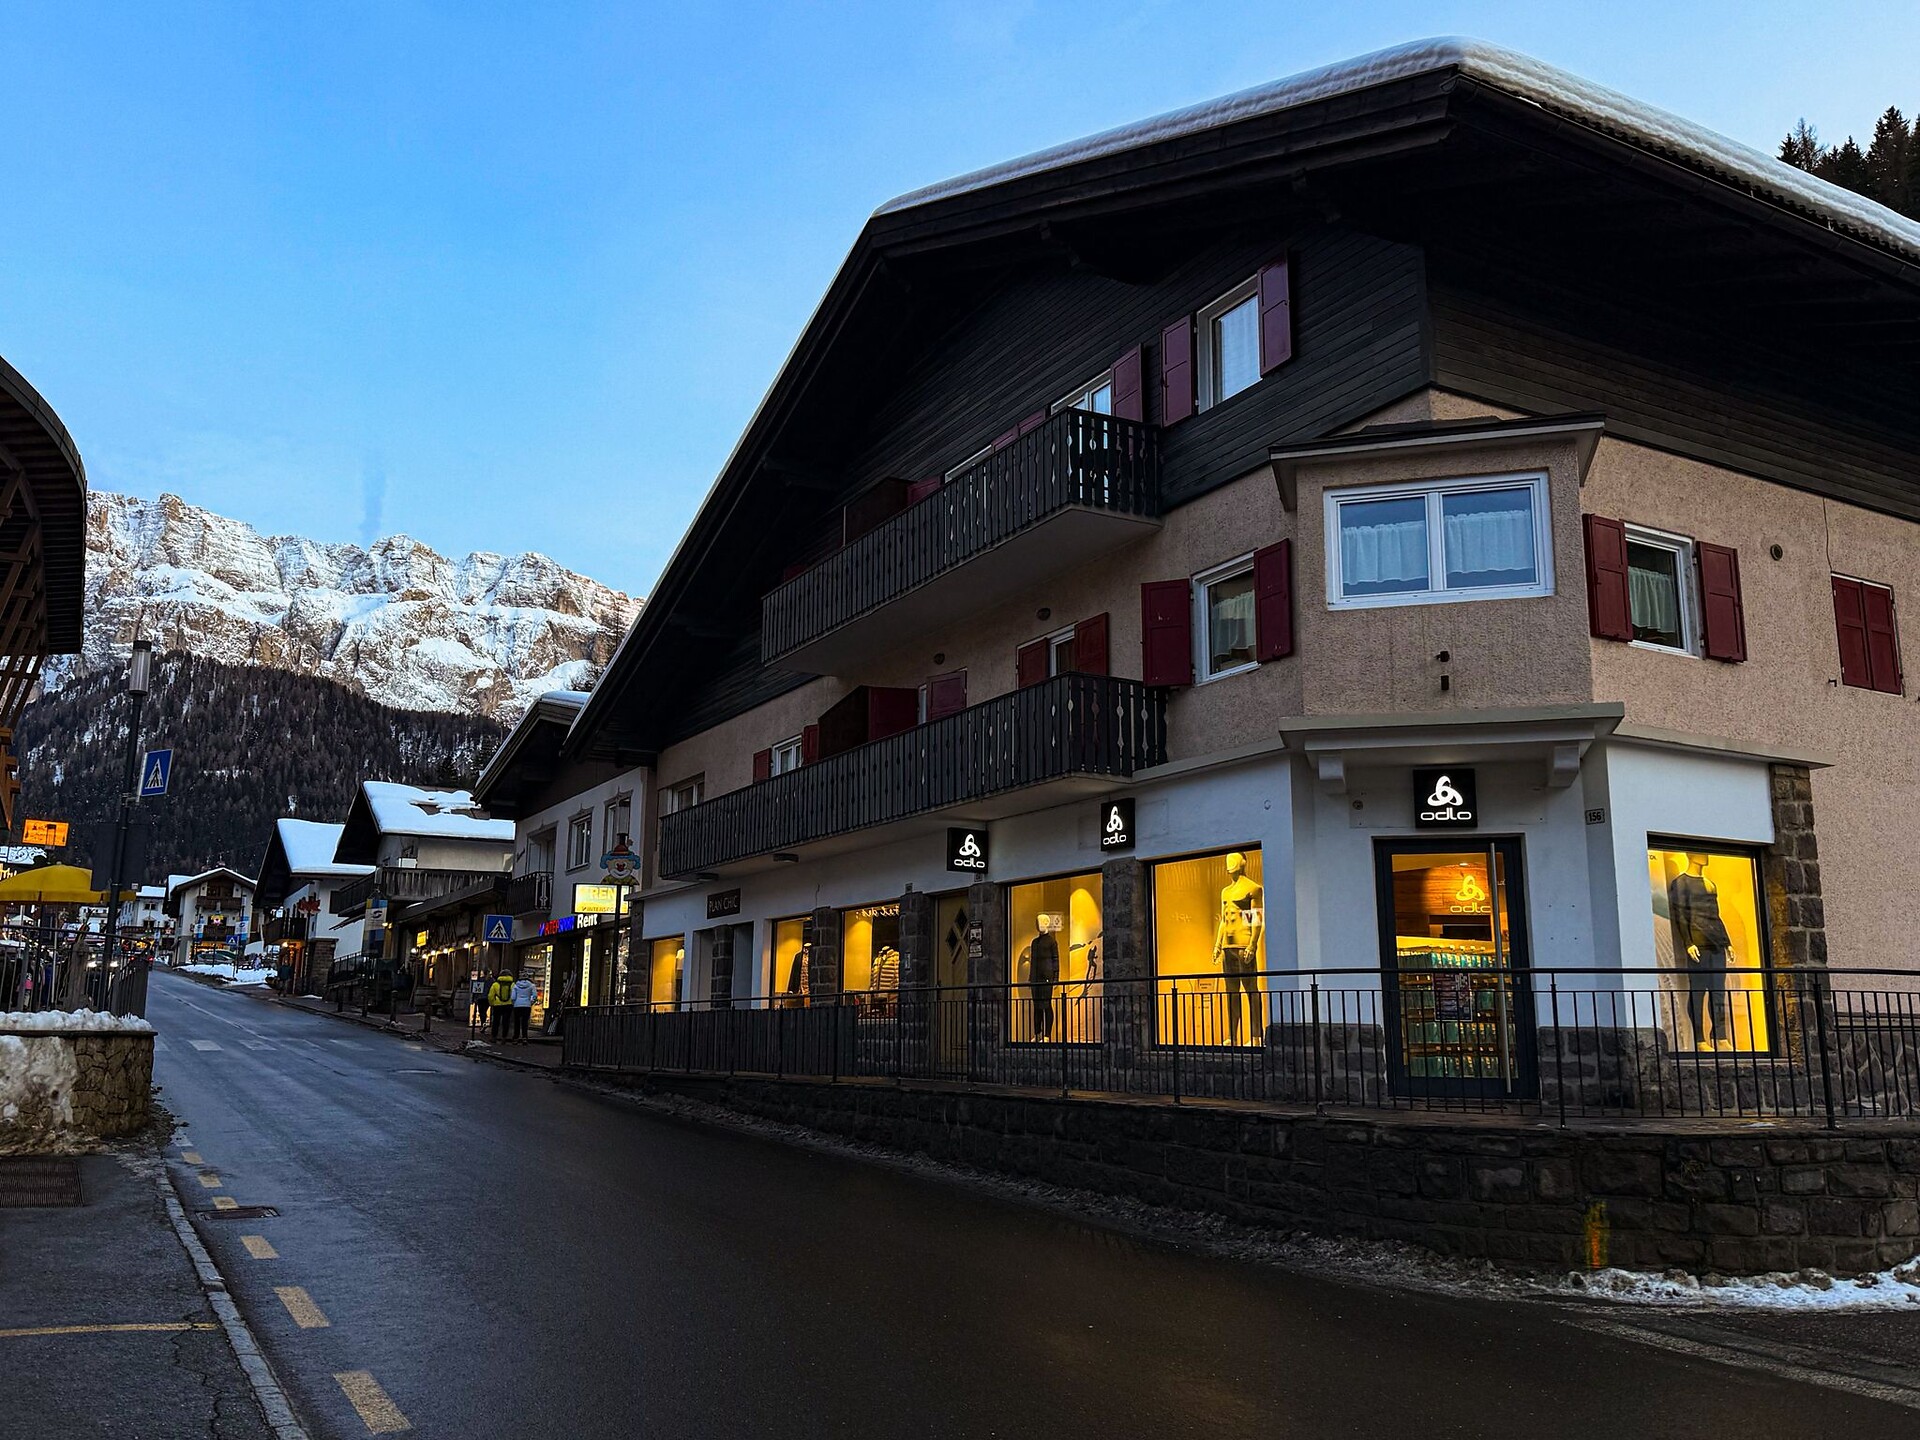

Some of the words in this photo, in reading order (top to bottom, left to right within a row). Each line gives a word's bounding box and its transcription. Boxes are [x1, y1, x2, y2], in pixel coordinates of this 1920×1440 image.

[1420, 807, 1472, 820] odlo
[1588, 811, 1601, 821] 156
[1102, 832, 1127, 845] odlo
[953, 857, 985, 868] odlo
[592, 887, 616, 900] REN
[576, 914, 599, 929] Rent
